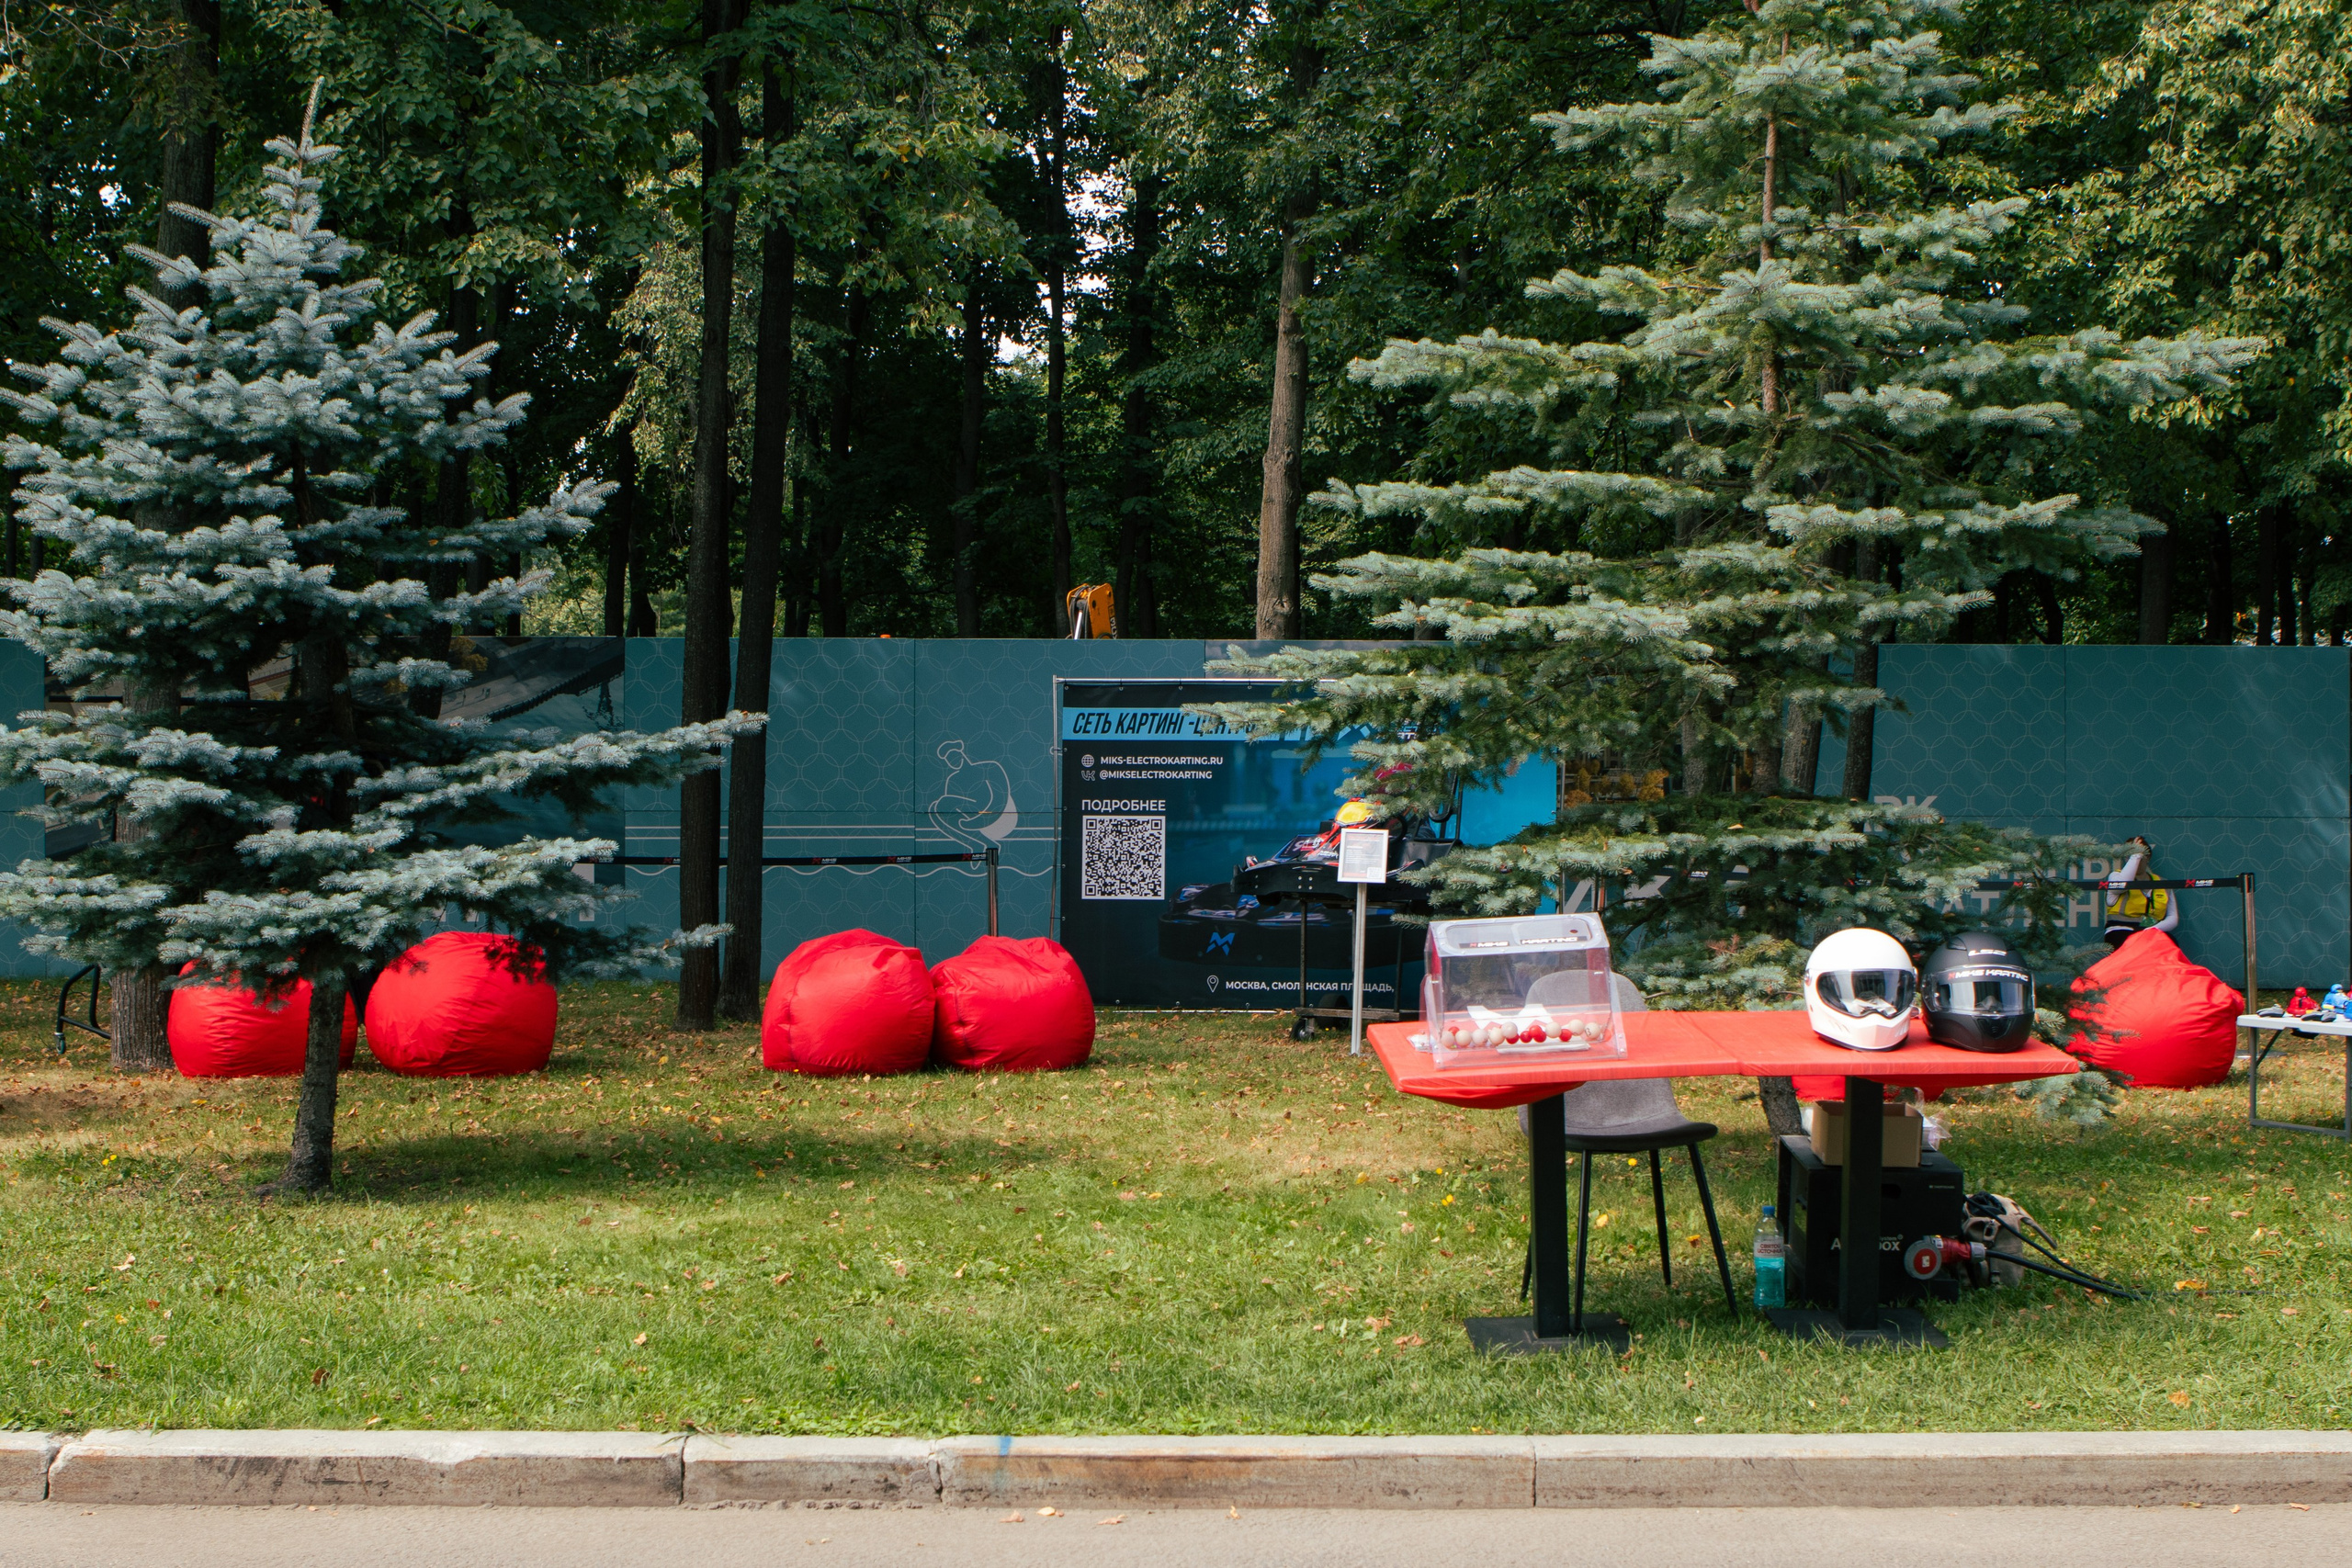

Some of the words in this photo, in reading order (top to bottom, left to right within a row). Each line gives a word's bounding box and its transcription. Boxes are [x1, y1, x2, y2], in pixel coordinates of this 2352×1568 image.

[1072, 712, 1112, 735] СЕТЬ
[1100, 756, 1224, 765] MIKS-ELECTROKARTING.RU
[1099, 770, 1213, 780] @MIKSELECTROKARTING
[1081, 799, 1167, 812] ПОДРОБНЕЕ
[1226, 981, 1270, 991] МОСКВА,
[1272, 982, 1338, 990] СМОЛНСКАЯ
[1340, 983, 1395, 993] ПЛЩАДЬ,
